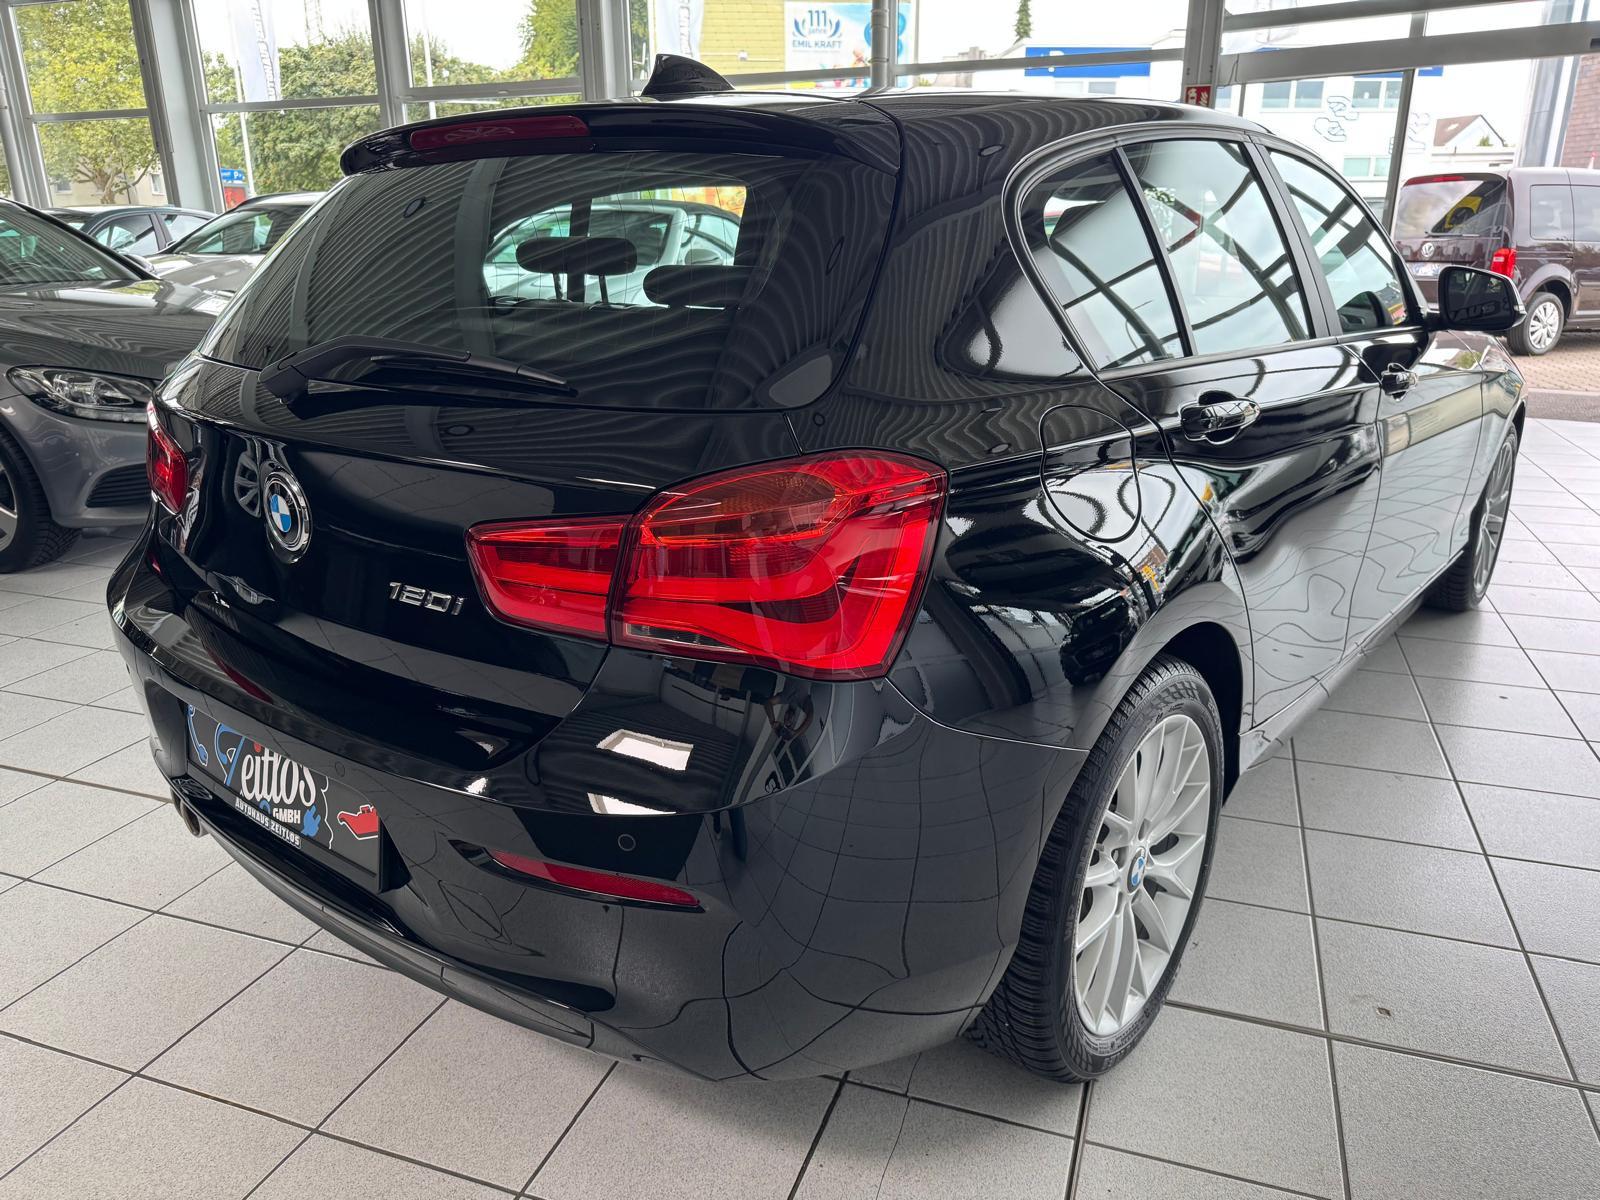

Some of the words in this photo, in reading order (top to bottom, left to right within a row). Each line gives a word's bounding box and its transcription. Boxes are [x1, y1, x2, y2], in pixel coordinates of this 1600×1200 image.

[807, 9, 827, 27] 111
[792, 40, 812, 48] EMIL
[814, 40, 842, 48] KRAFT
[389, 581, 465, 616] 120i
[235, 797, 270, 829] AUTOHAUS
[270, 820, 301, 847] ZEITLOS
[272, 807, 301, 824] GMBH
